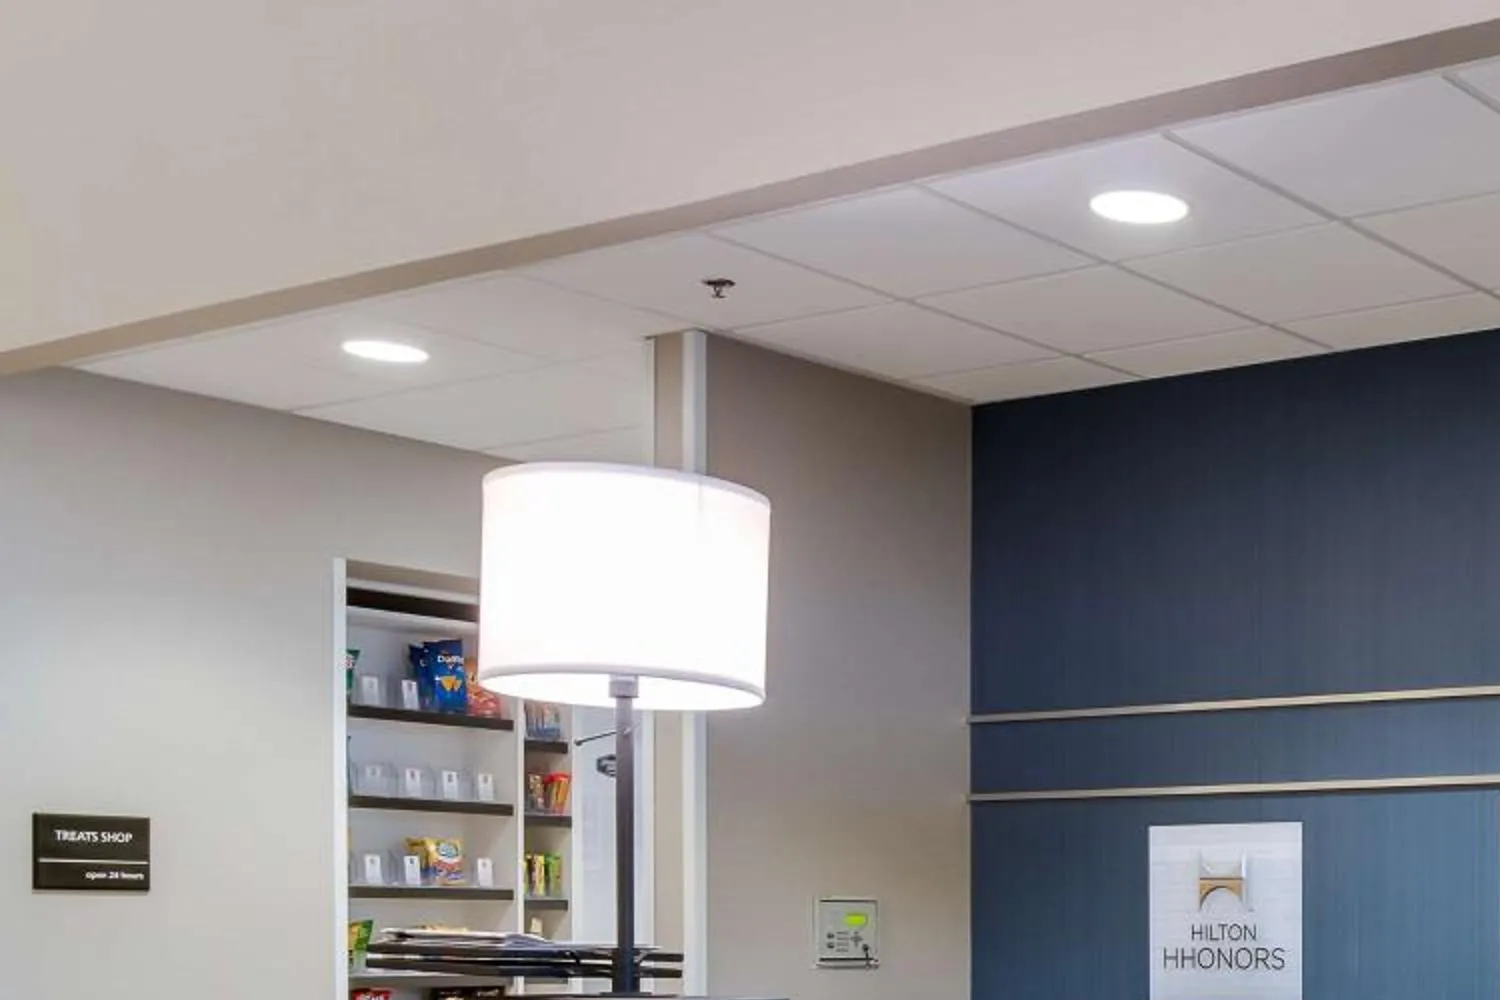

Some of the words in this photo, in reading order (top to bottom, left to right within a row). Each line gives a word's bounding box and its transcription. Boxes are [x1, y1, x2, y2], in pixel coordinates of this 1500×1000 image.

[54, 829, 98, 843] TREATS
[101, 831, 133, 843] SHOP
[85, 870, 107, 880] open
[108, 871, 119, 880] 24
[120, 871, 144, 880] hours
[1190, 923, 1257, 941] HILTON
[1163, 947, 1286, 970] HHONORS
